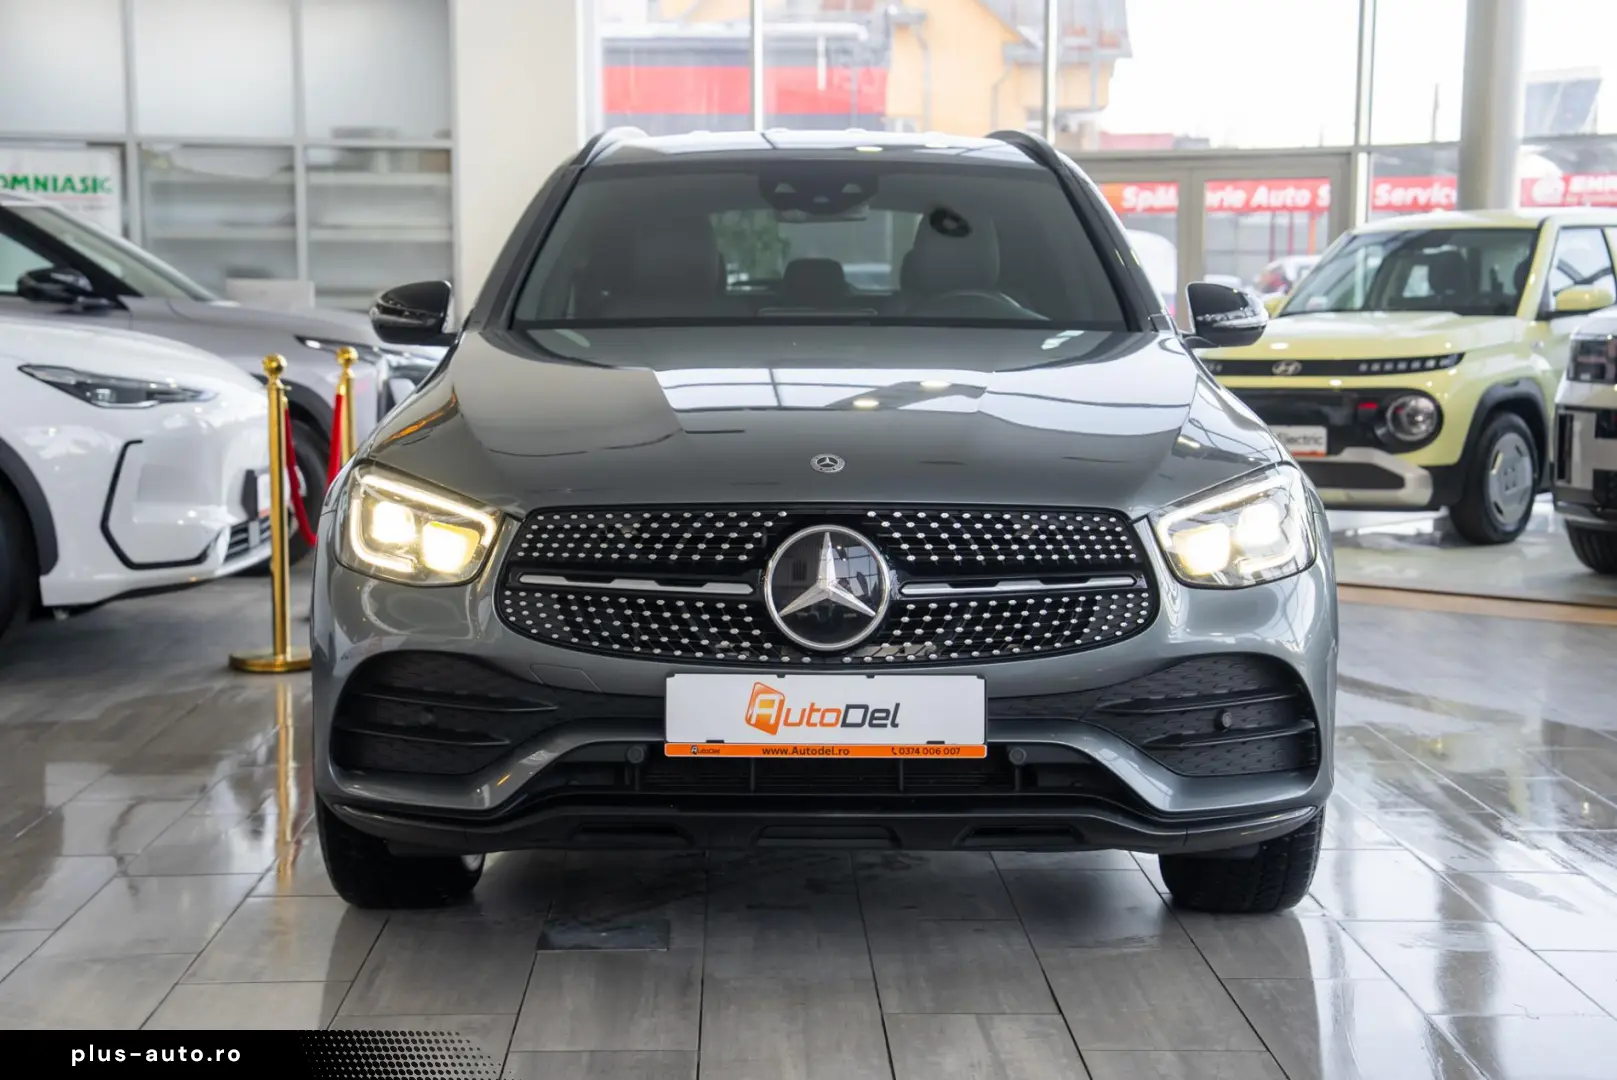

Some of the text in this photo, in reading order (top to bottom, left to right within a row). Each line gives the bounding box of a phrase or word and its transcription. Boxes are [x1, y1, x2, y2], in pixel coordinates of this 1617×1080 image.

[1250, 185, 1312, 207] Auto
[745, 681, 901, 736] AutoDel
[761, 745, 850, 757] www.Autodel.ro
[898, 746, 961, 756] 0374 006 007
